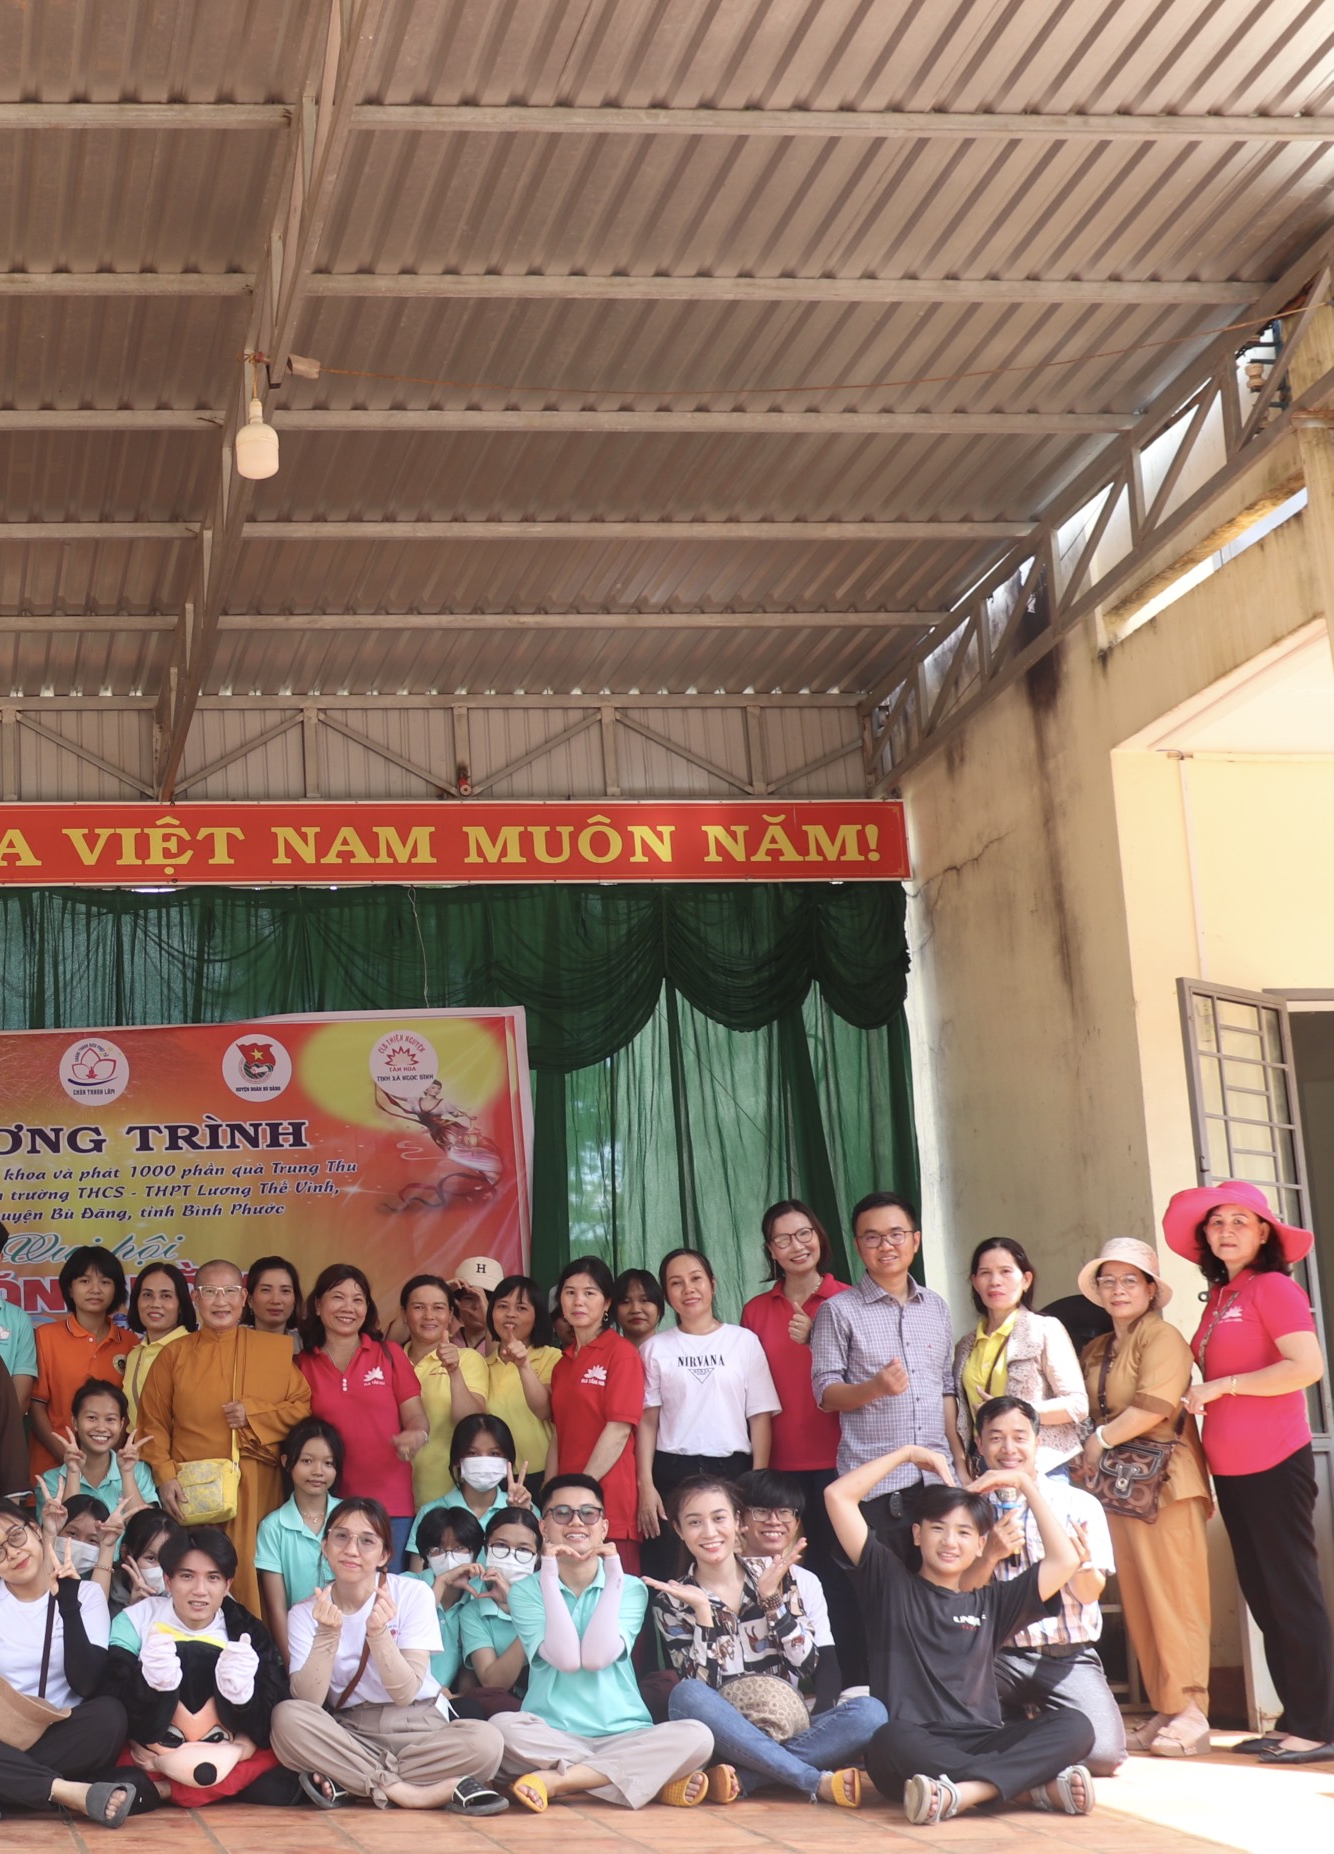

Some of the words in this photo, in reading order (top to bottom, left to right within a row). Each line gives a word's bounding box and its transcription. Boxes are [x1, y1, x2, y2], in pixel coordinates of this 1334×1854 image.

[62, 815, 245, 875] VIỆT
[271, 825, 437, 865] NAM
[463, 814, 676, 864] MUÔN
[701, 813, 880, 863] NĂM!
[125, 1115, 309, 1152] TRÌNH
[4, 1168, 46, 1181] khoa
[53, 1168, 73, 1180] và
[79, 1166, 120, 1181] phát
[131, 1165, 176, 1178] 1000
[180, 1162, 224, 1179] phần
[232, 1163, 264, 1178] quà
[272, 1162, 319, 1176] Trung
[327, 1159, 357, 1172] Thu
[11, 1189, 70, 1203] trường
[78, 1186, 125, 1198] THCS
[146, 1185, 191, 1197] THPT
[197, 1184, 252, 1198] Lương
[260, 1181, 288, 1194] Thế
[51, 1207, 74, 1220] Bù
[81, 1207, 132, 1221] Đăng,
[140, 1205, 174, 1217] tỉnh
[182, 1203, 222, 1217] Bình
[230, 1202, 285, 1216] Phước
[112, 1234, 184, 1265] hội
[476, 1263, 486, 1273] H
[677, 1354, 725, 1367] NIRVANA
